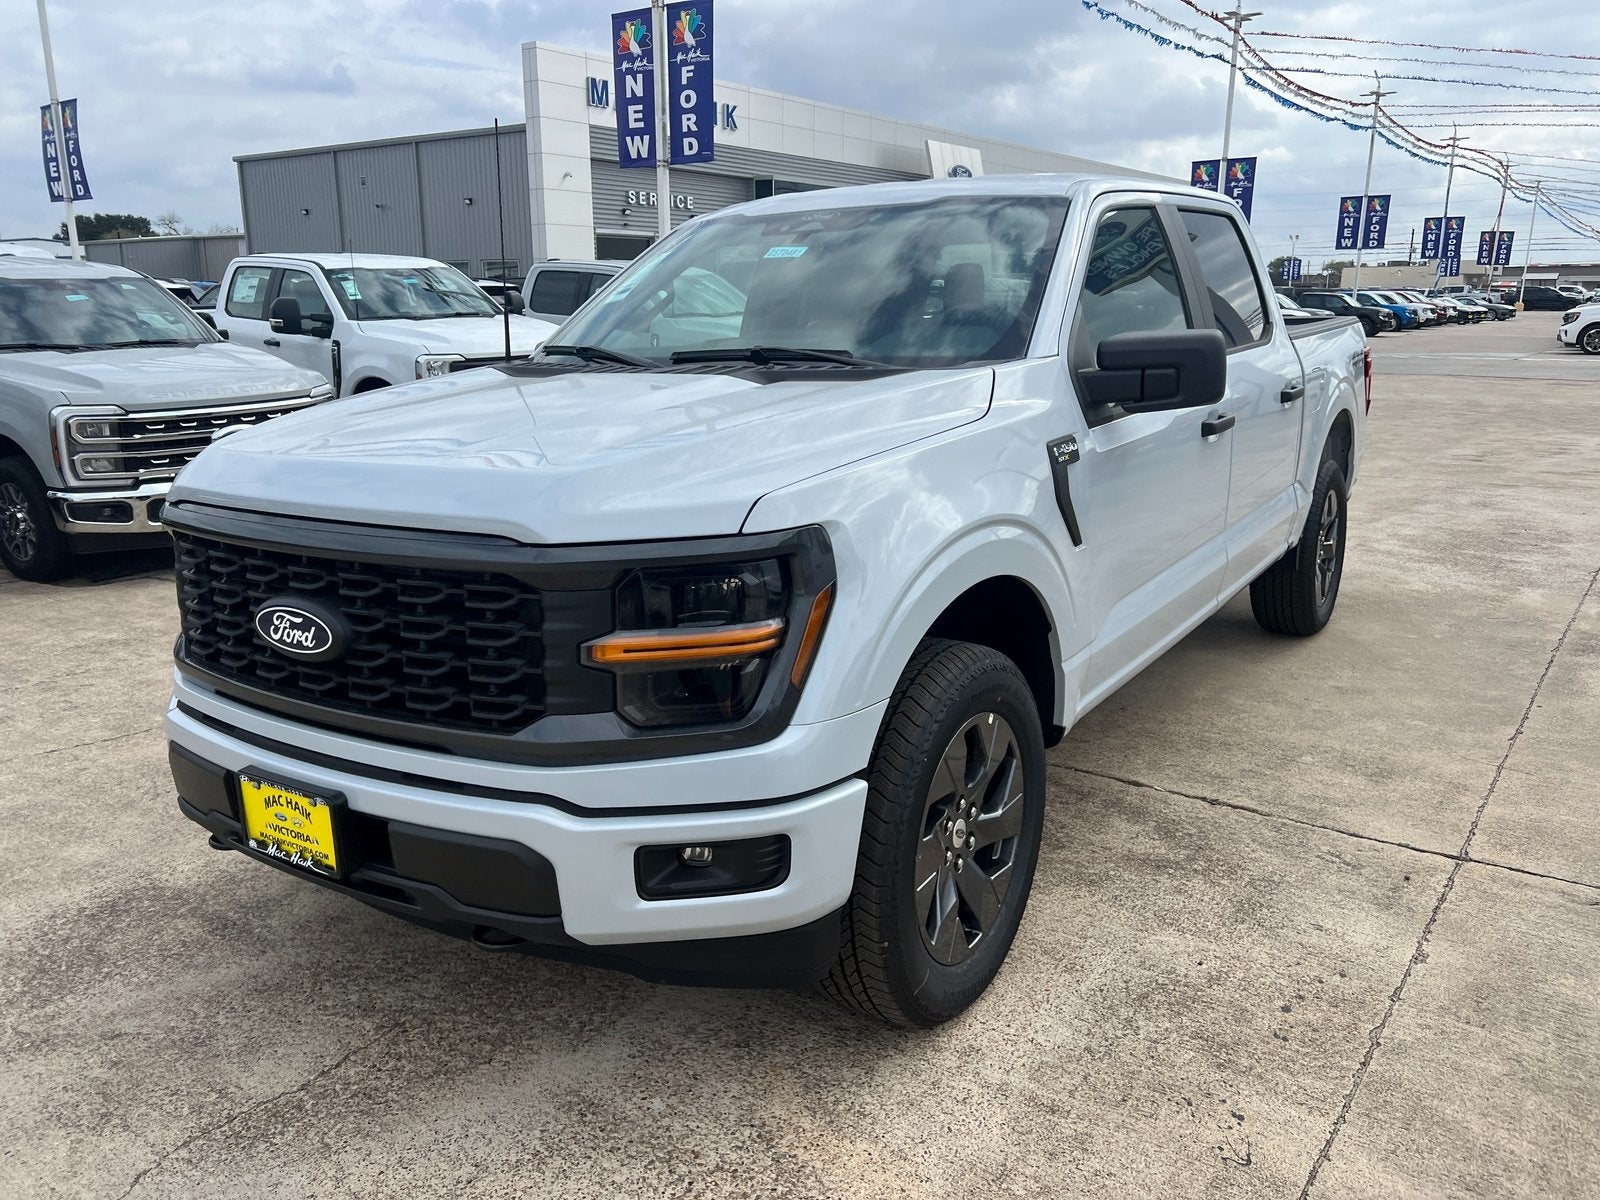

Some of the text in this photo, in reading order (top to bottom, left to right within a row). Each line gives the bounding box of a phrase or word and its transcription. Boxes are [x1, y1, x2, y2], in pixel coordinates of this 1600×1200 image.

[625, 73, 650, 159] NEW
[679, 65, 699, 156] FORD
[46, 142, 63, 197] NEW
[68, 140, 85, 196] FORD
[628, 190, 694, 209] SERICE
[1341, 217, 1354, 248] NEW
[1368, 216, 1381, 247] FORD
[1425, 233, 1436, 257] NEW
[1447, 232, 1457, 257] FORD
[1480, 244, 1490, 264] NEW
[1498, 244, 1508, 264] FORD
[270, 611, 316, 648] Ford
[264, 794, 284, 810] MAC
[285, 796, 313, 825] HAIK
[270, 822, 312, 844] VICTORIA
[264, 843, 287, 860] Mac
